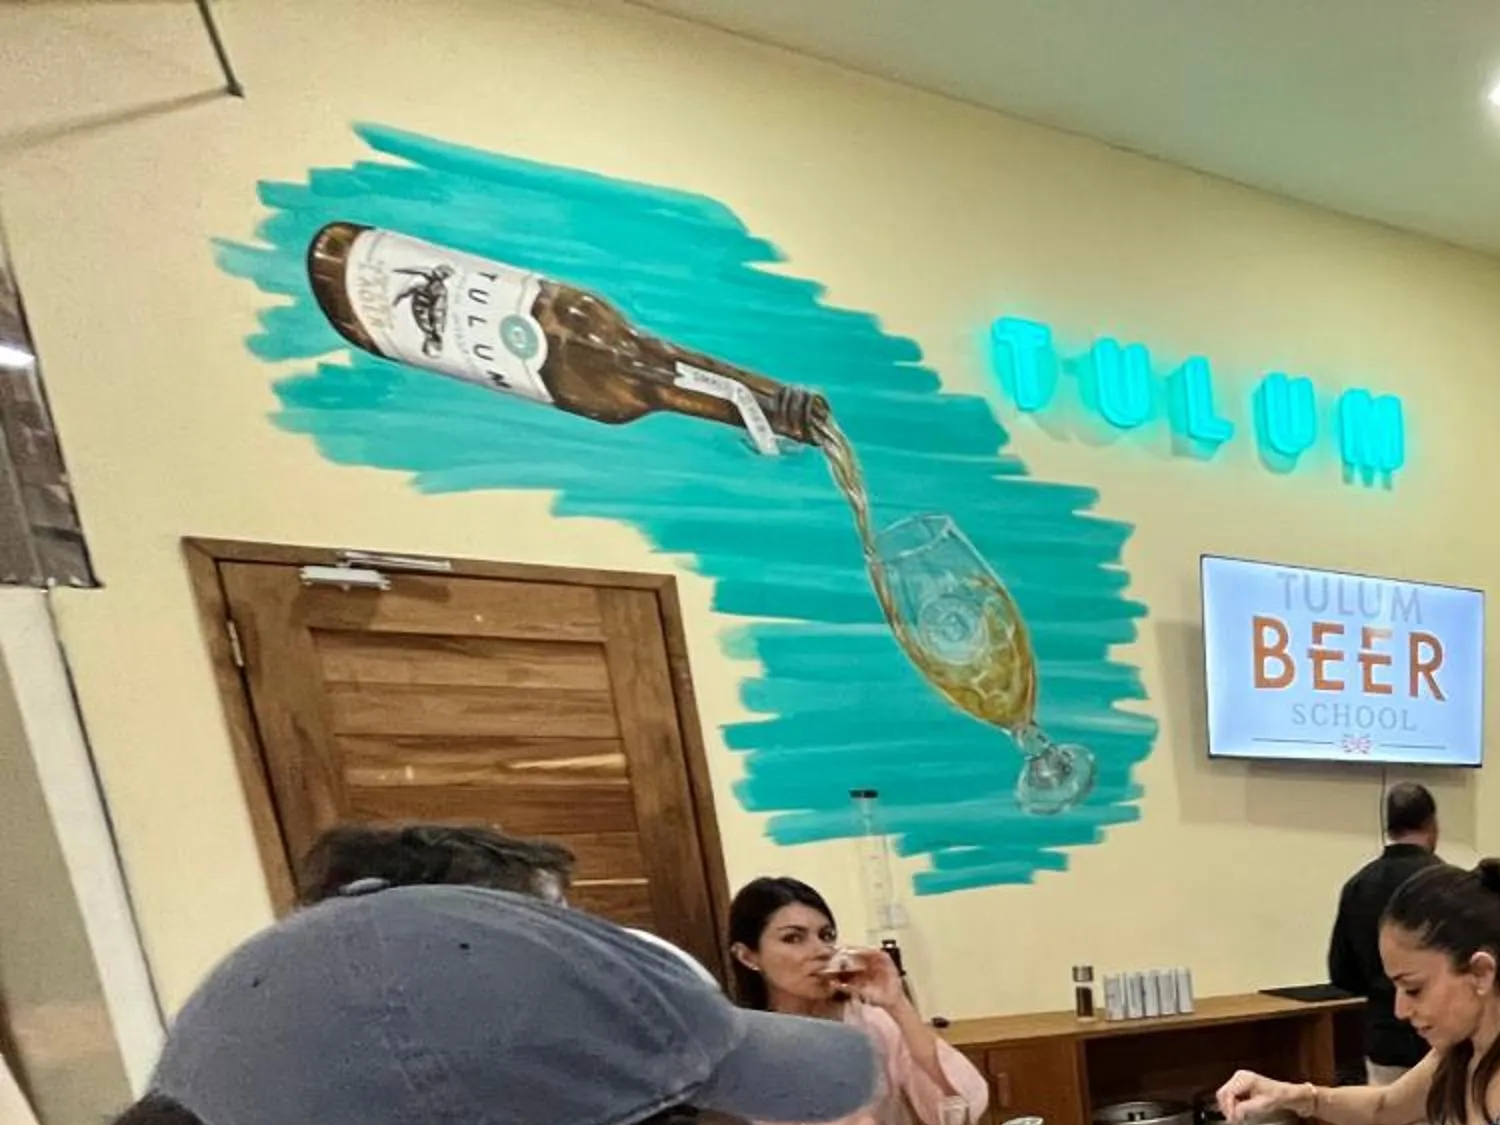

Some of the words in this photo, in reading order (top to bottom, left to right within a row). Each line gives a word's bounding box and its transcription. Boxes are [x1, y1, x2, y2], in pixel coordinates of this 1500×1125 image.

[468, 271, 512, 389] TULUM
[992, 317, 1405, 472] TULUM
[1277, 572, 1422, 624] TULUM
[1252, 615, 1446, 701] BEER
[1291, 703, 1417, 731] SCHOOL
